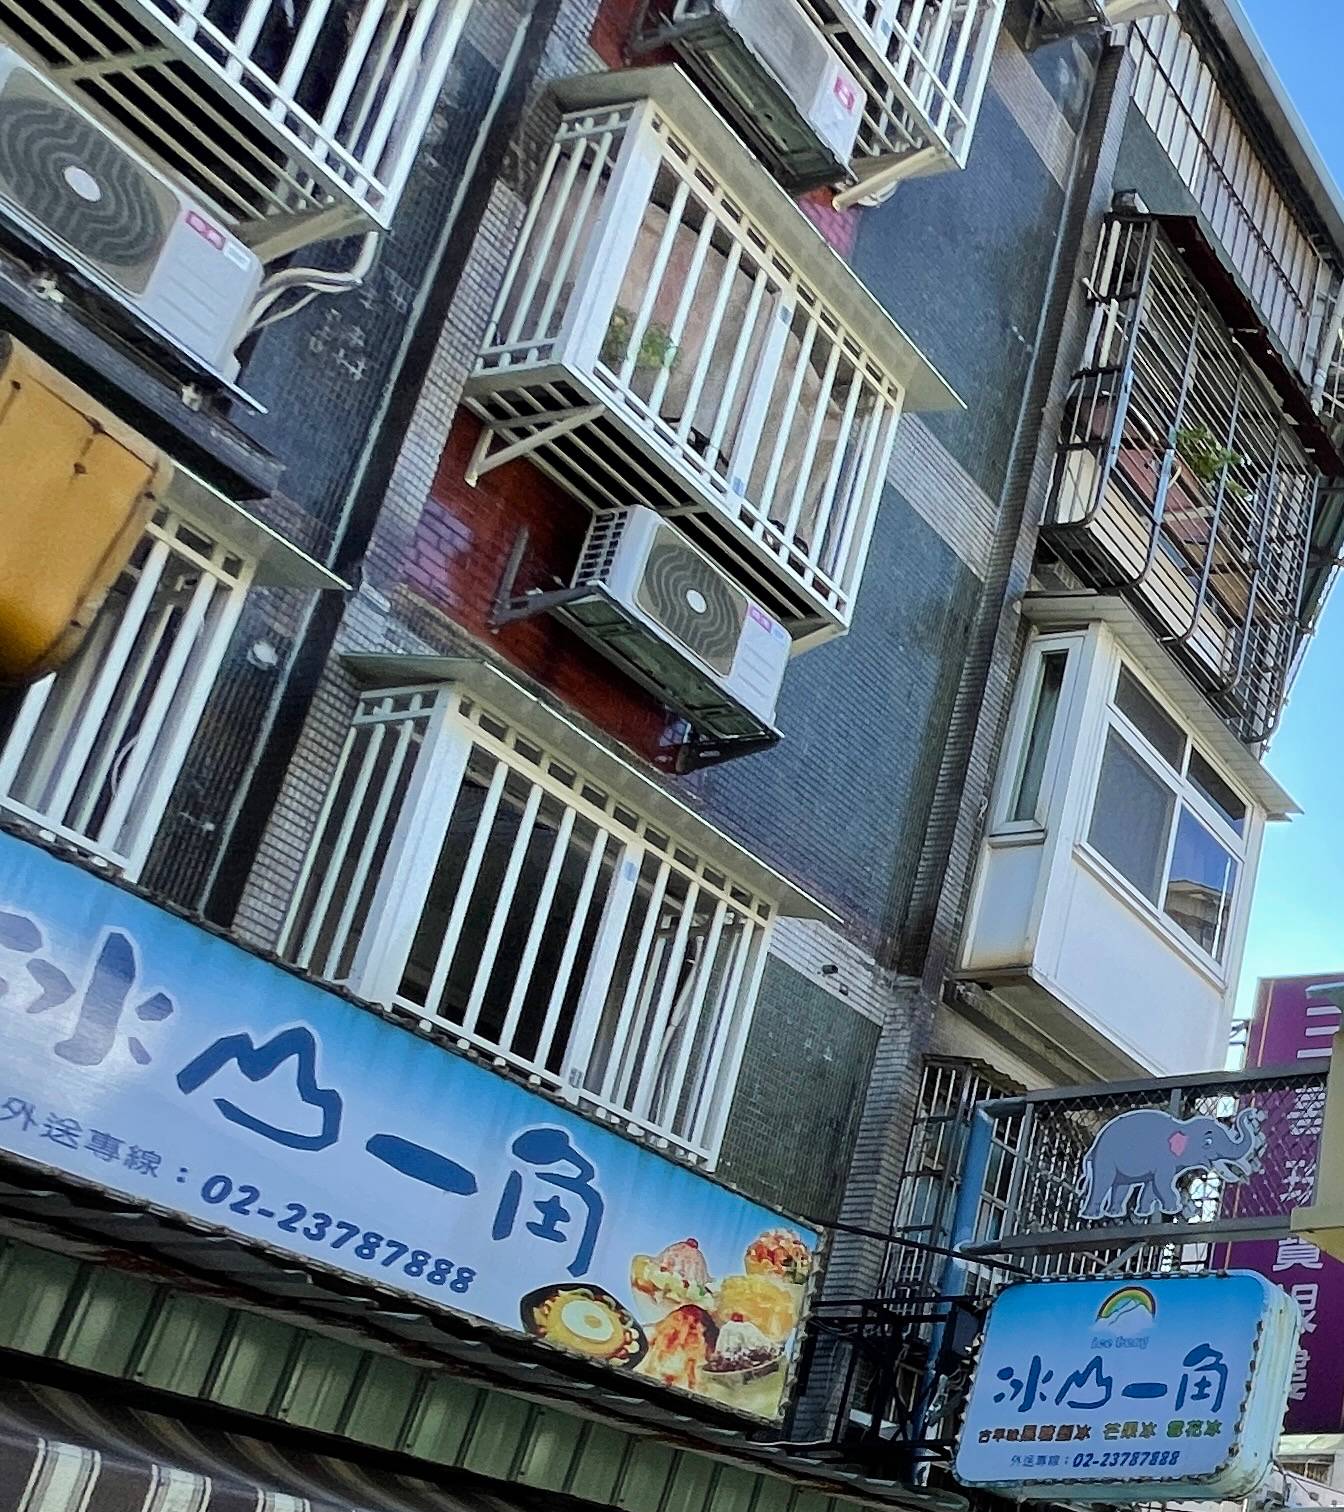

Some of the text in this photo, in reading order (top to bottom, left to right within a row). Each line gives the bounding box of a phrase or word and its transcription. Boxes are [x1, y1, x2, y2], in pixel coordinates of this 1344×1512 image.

[201, 1173, 477, 1295] 02-23787888
[994, 1343, 1228, 1413] 冰山一角
[1072, 1451, 1180, 1468] 02-23787888
